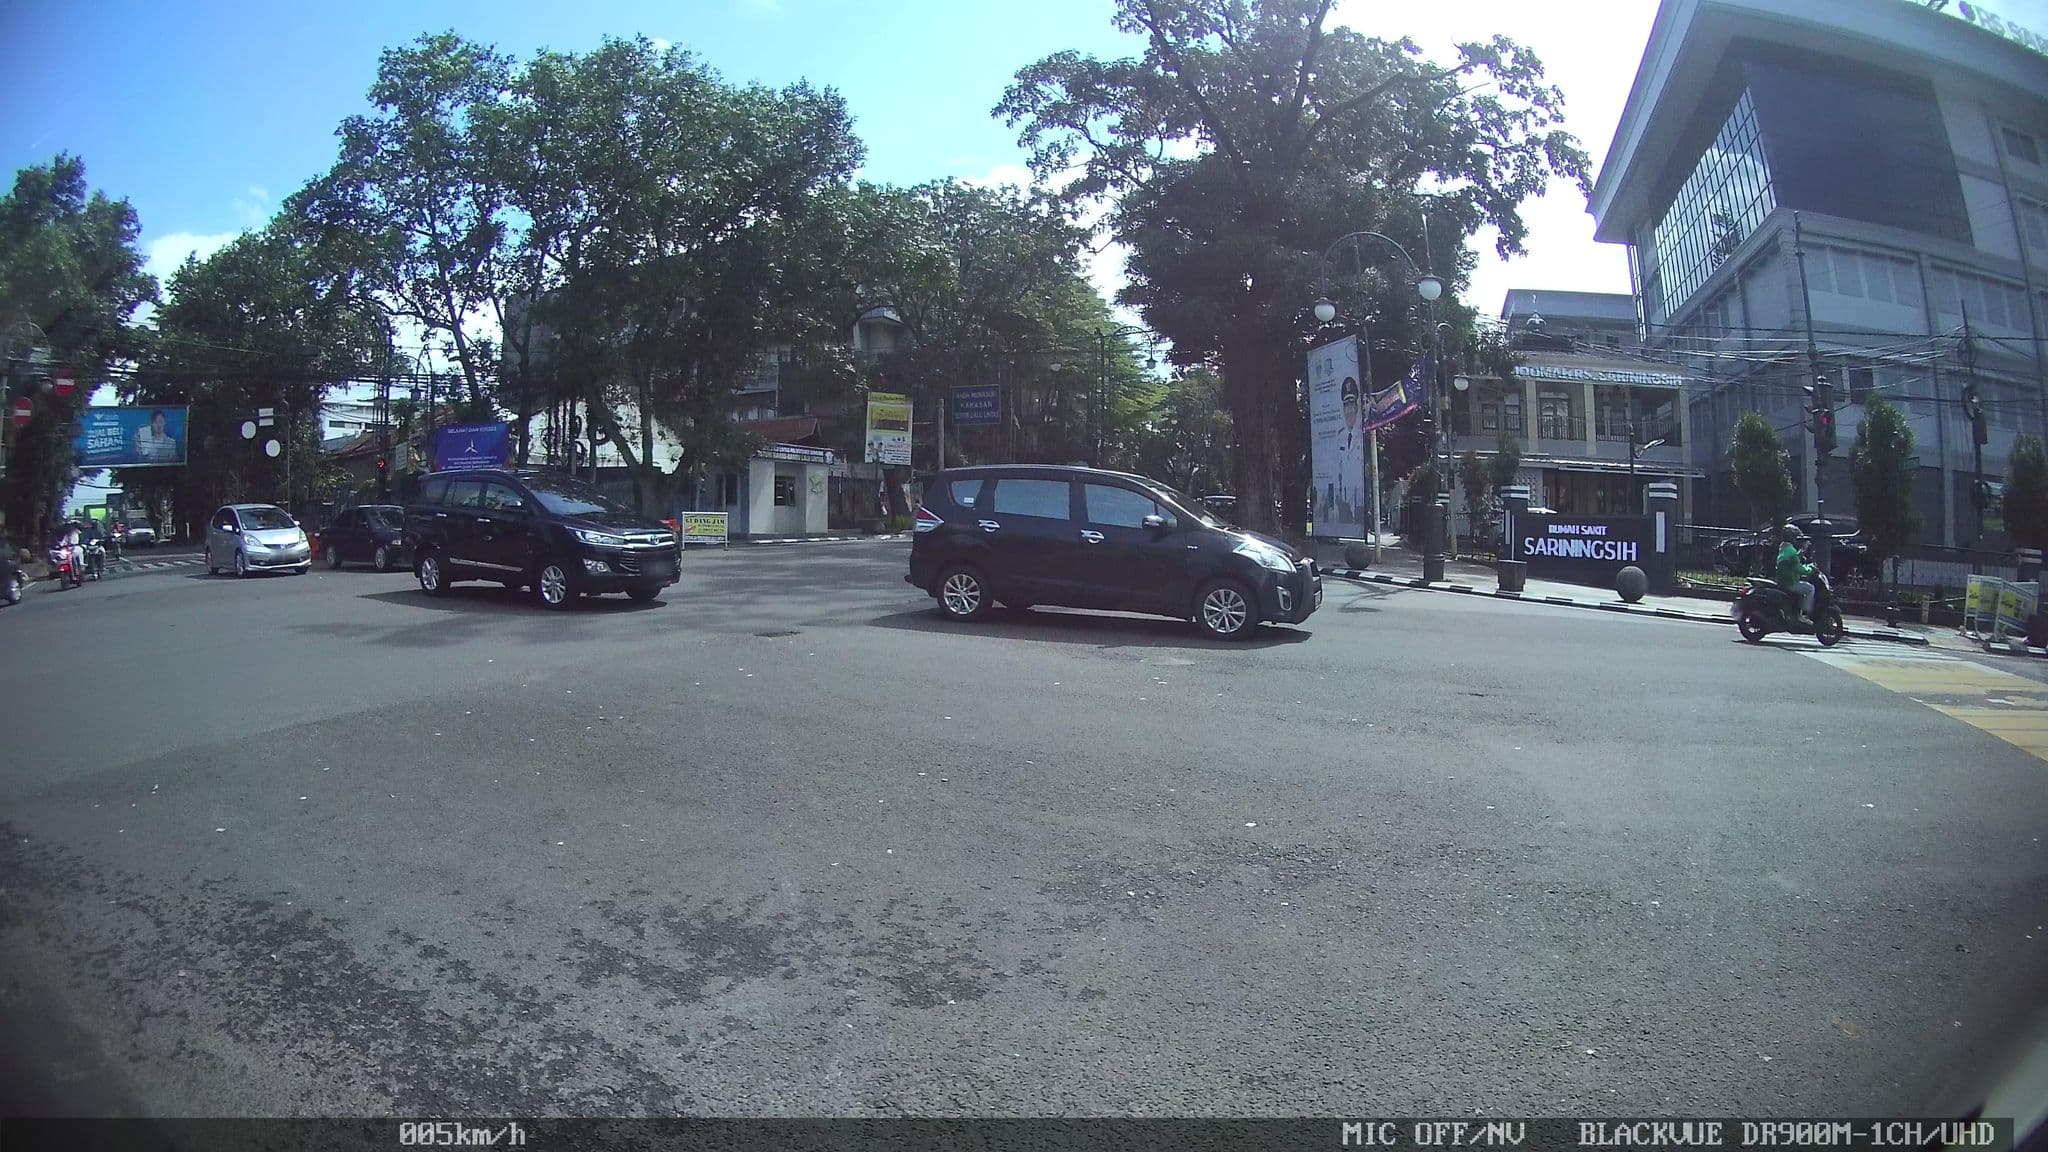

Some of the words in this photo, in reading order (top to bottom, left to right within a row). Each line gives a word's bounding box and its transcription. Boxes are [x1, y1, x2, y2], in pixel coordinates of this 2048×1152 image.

[87, 437, 123, 449] SAHAM
[1548, 524, 1579, 534] RUMAH
[1581, 525, 1608, 536] SAKIT
[1523, 537, 1637, 562] SARININGSIH
